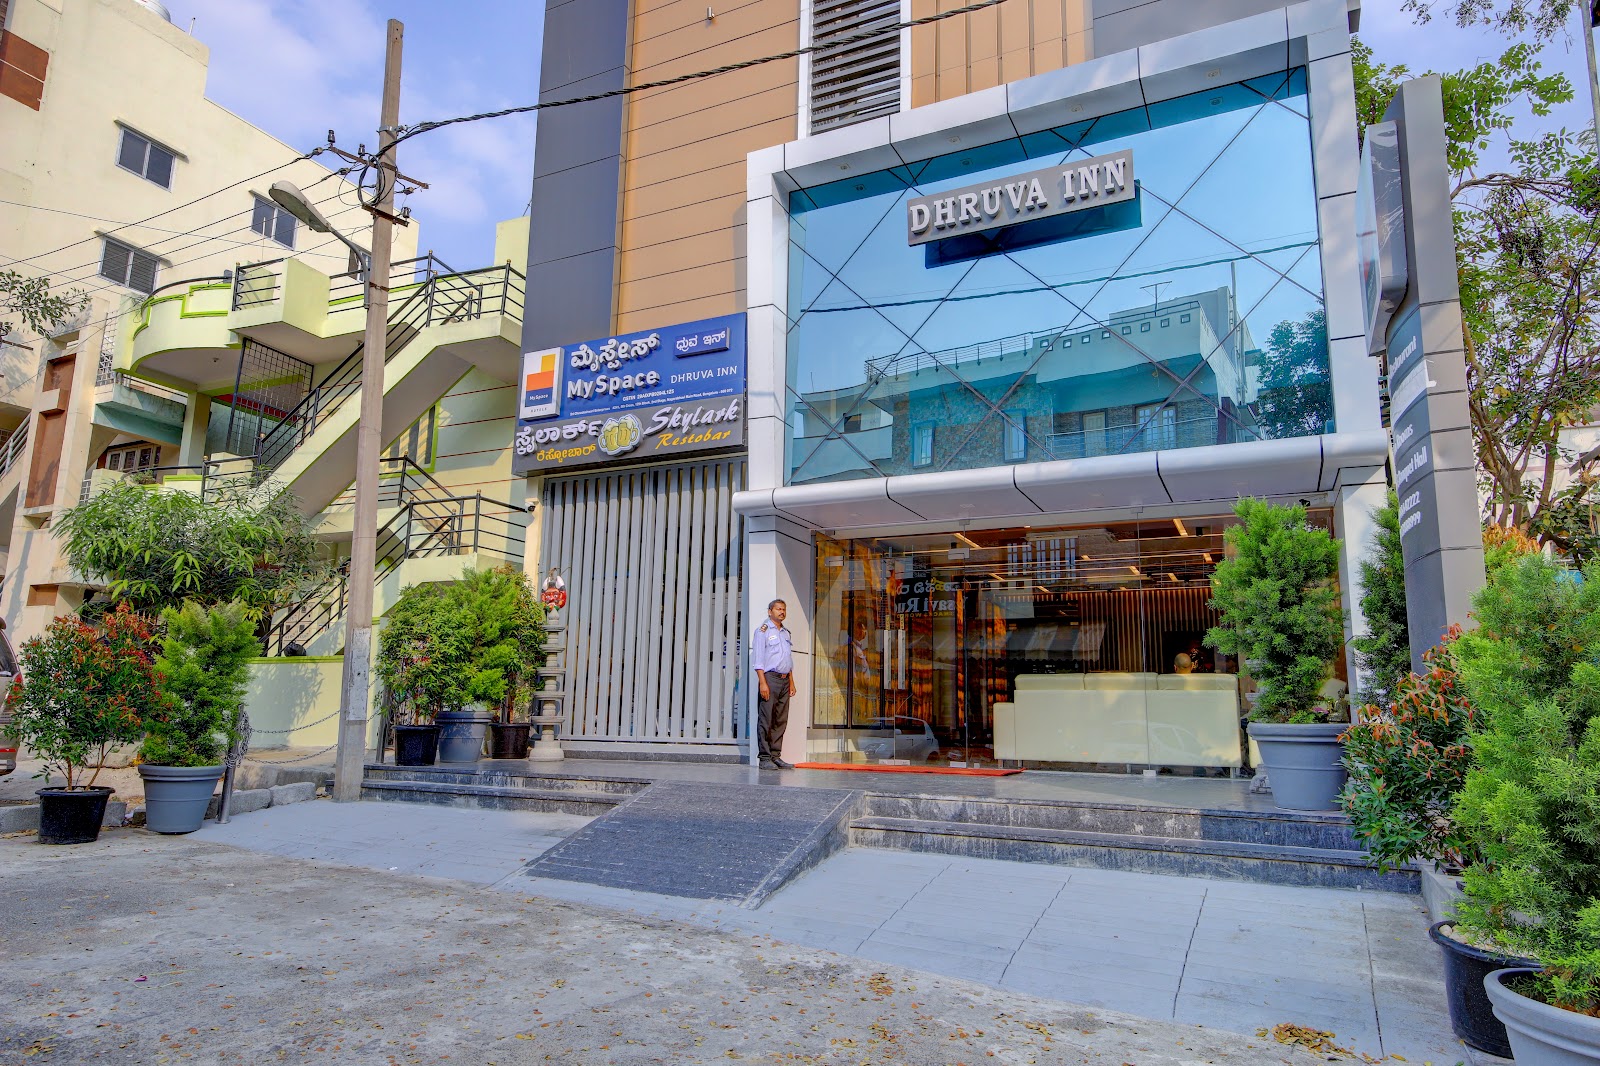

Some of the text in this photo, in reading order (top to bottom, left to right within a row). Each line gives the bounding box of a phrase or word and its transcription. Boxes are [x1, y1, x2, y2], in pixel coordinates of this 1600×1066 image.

[909, 157, 1127, 234] DHRUVA INN
[570, 332, 660, 372] ಮೈಸ್ಪೇಸ್
[676, 330, 726, 352] ಧ್ರುವ ಇನ್
[567, 370, 660, 399] MySpace
[670, 365, 738, 384] DHRUVA INN
[643, 398, 739, 434] Skylark
[655, 428, 732, 450] Restobar
[536, 443, 597, 463] ರೆಸ್ಟೋಬಾರ್
[1413, 445, 1428, 470] Hall
